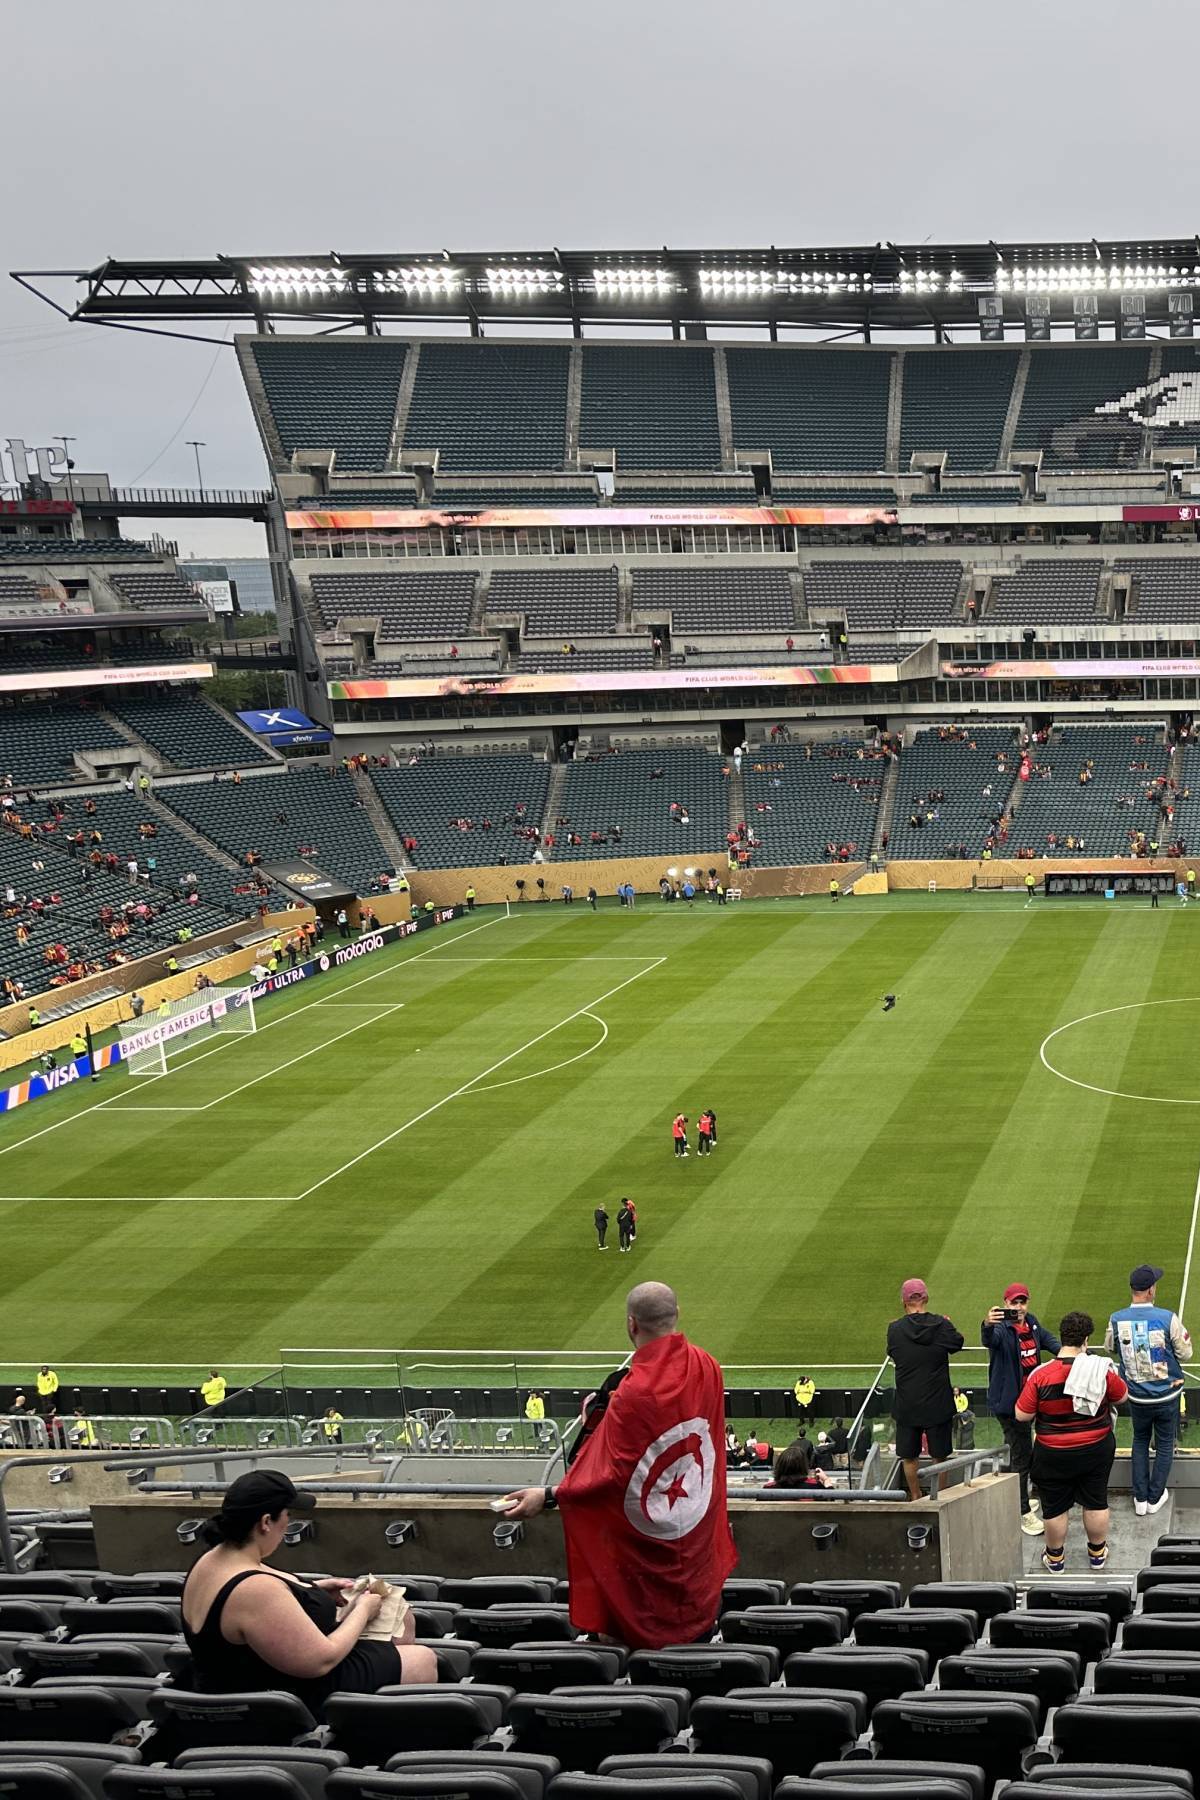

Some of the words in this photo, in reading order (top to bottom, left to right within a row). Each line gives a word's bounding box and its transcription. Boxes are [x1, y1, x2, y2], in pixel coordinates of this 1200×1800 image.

[1075, 296, 1097, 316] 44
[1170, 294, 1193, 314] 70
[442, 908, 454, 922] PIF
[406, 921, 418, 935] PIF
[335, 934, 384, 966] motorola
[274, 967, 306, 989] ULTRA
[121, 1035, 152, 1055] BANK
[168, 1006, 213, 1035] AMERICA
[40, 1062, 80, 1091] VISA
